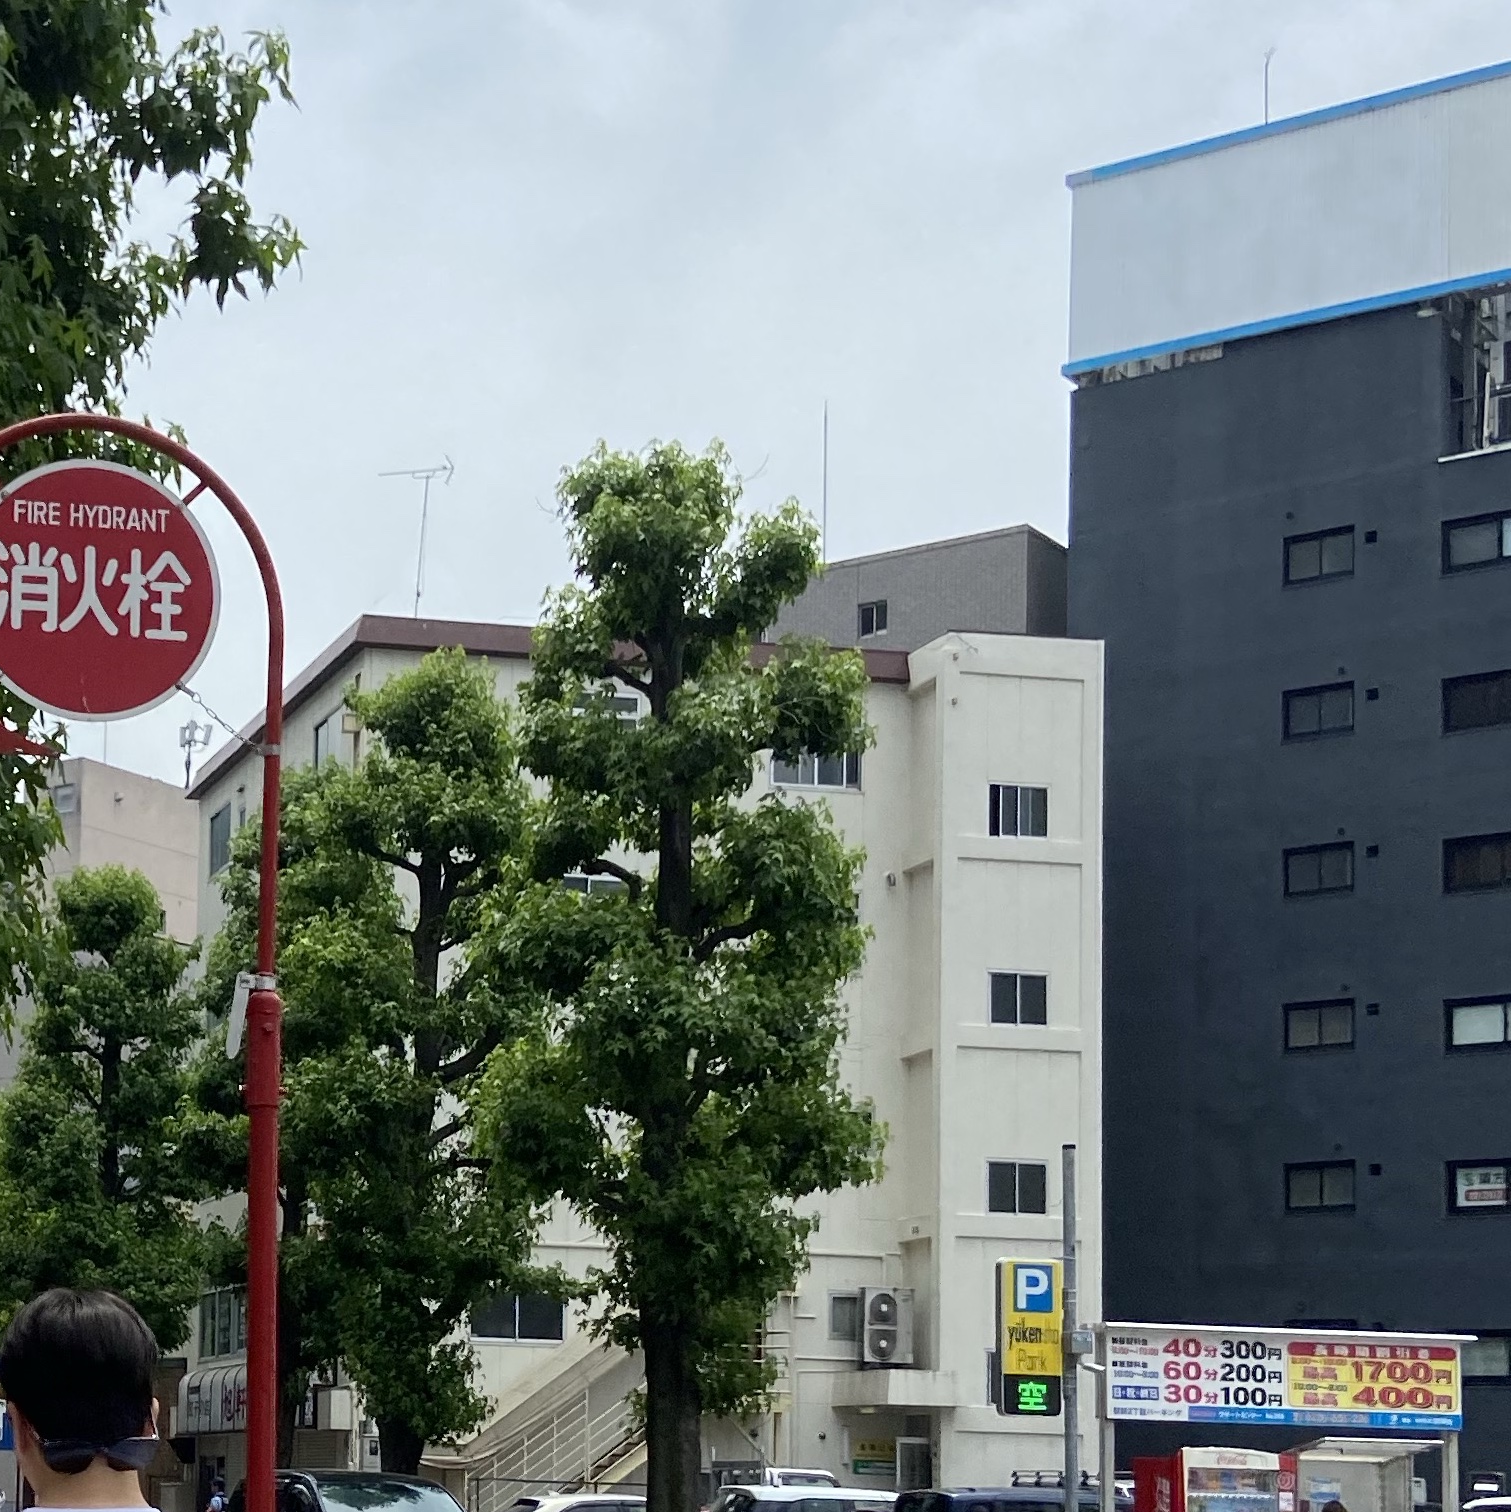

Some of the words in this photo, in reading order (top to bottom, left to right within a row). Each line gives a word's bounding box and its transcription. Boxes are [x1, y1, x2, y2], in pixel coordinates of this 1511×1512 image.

[13, 499, 61, 526] FIRE
[69, 503, 170, 533] HYDRANT
[1017, 1268, 1048, 1309] P
